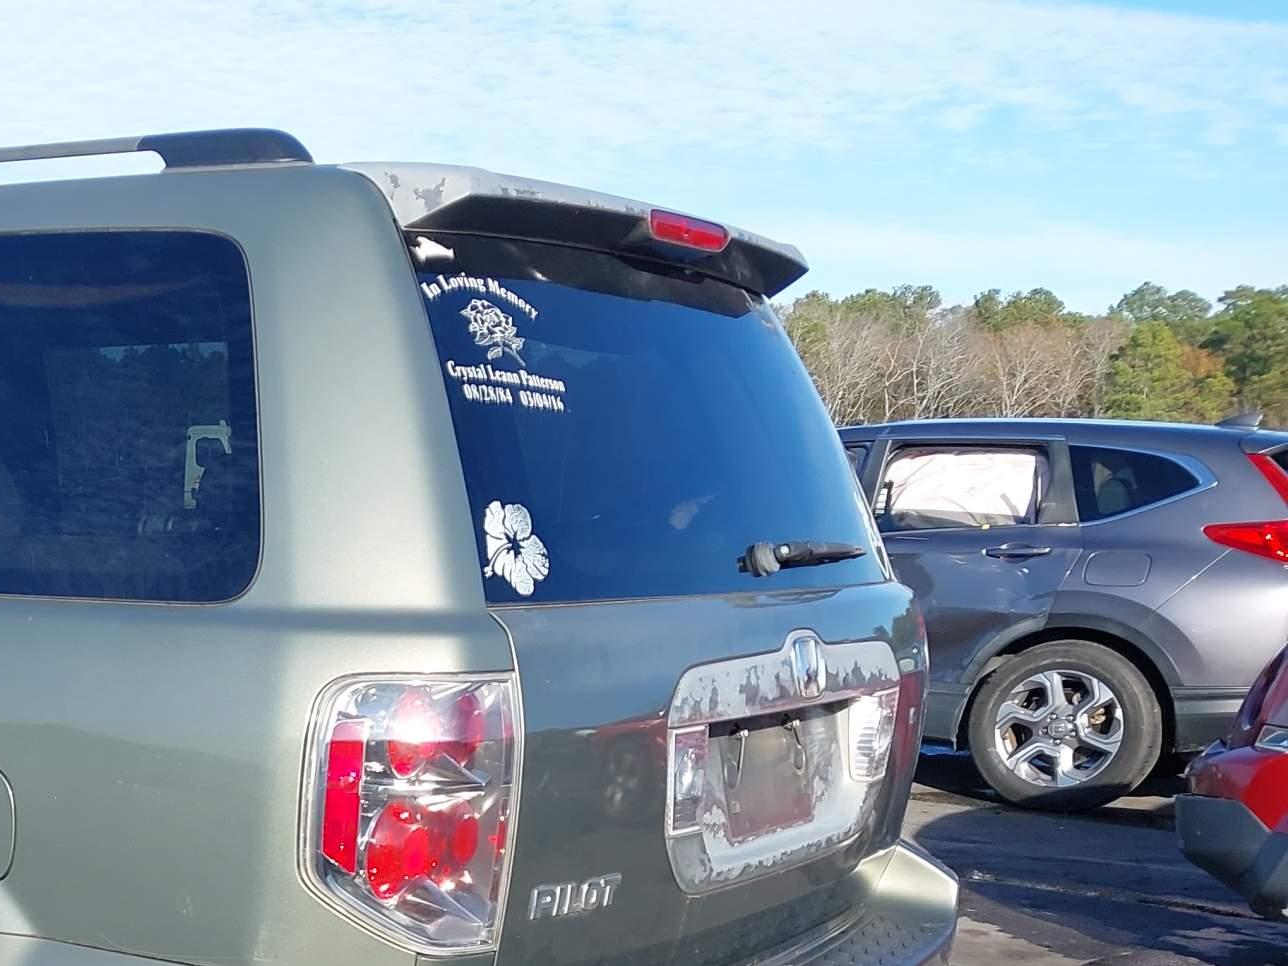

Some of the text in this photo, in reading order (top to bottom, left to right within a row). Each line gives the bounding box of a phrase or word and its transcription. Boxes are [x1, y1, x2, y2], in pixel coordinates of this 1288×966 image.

[420, 272, 539, 321] In Loving Memory
[446, 360, 566, 392] Crystal Leann Patterson
[528, 872, 622, 921] PILOT
